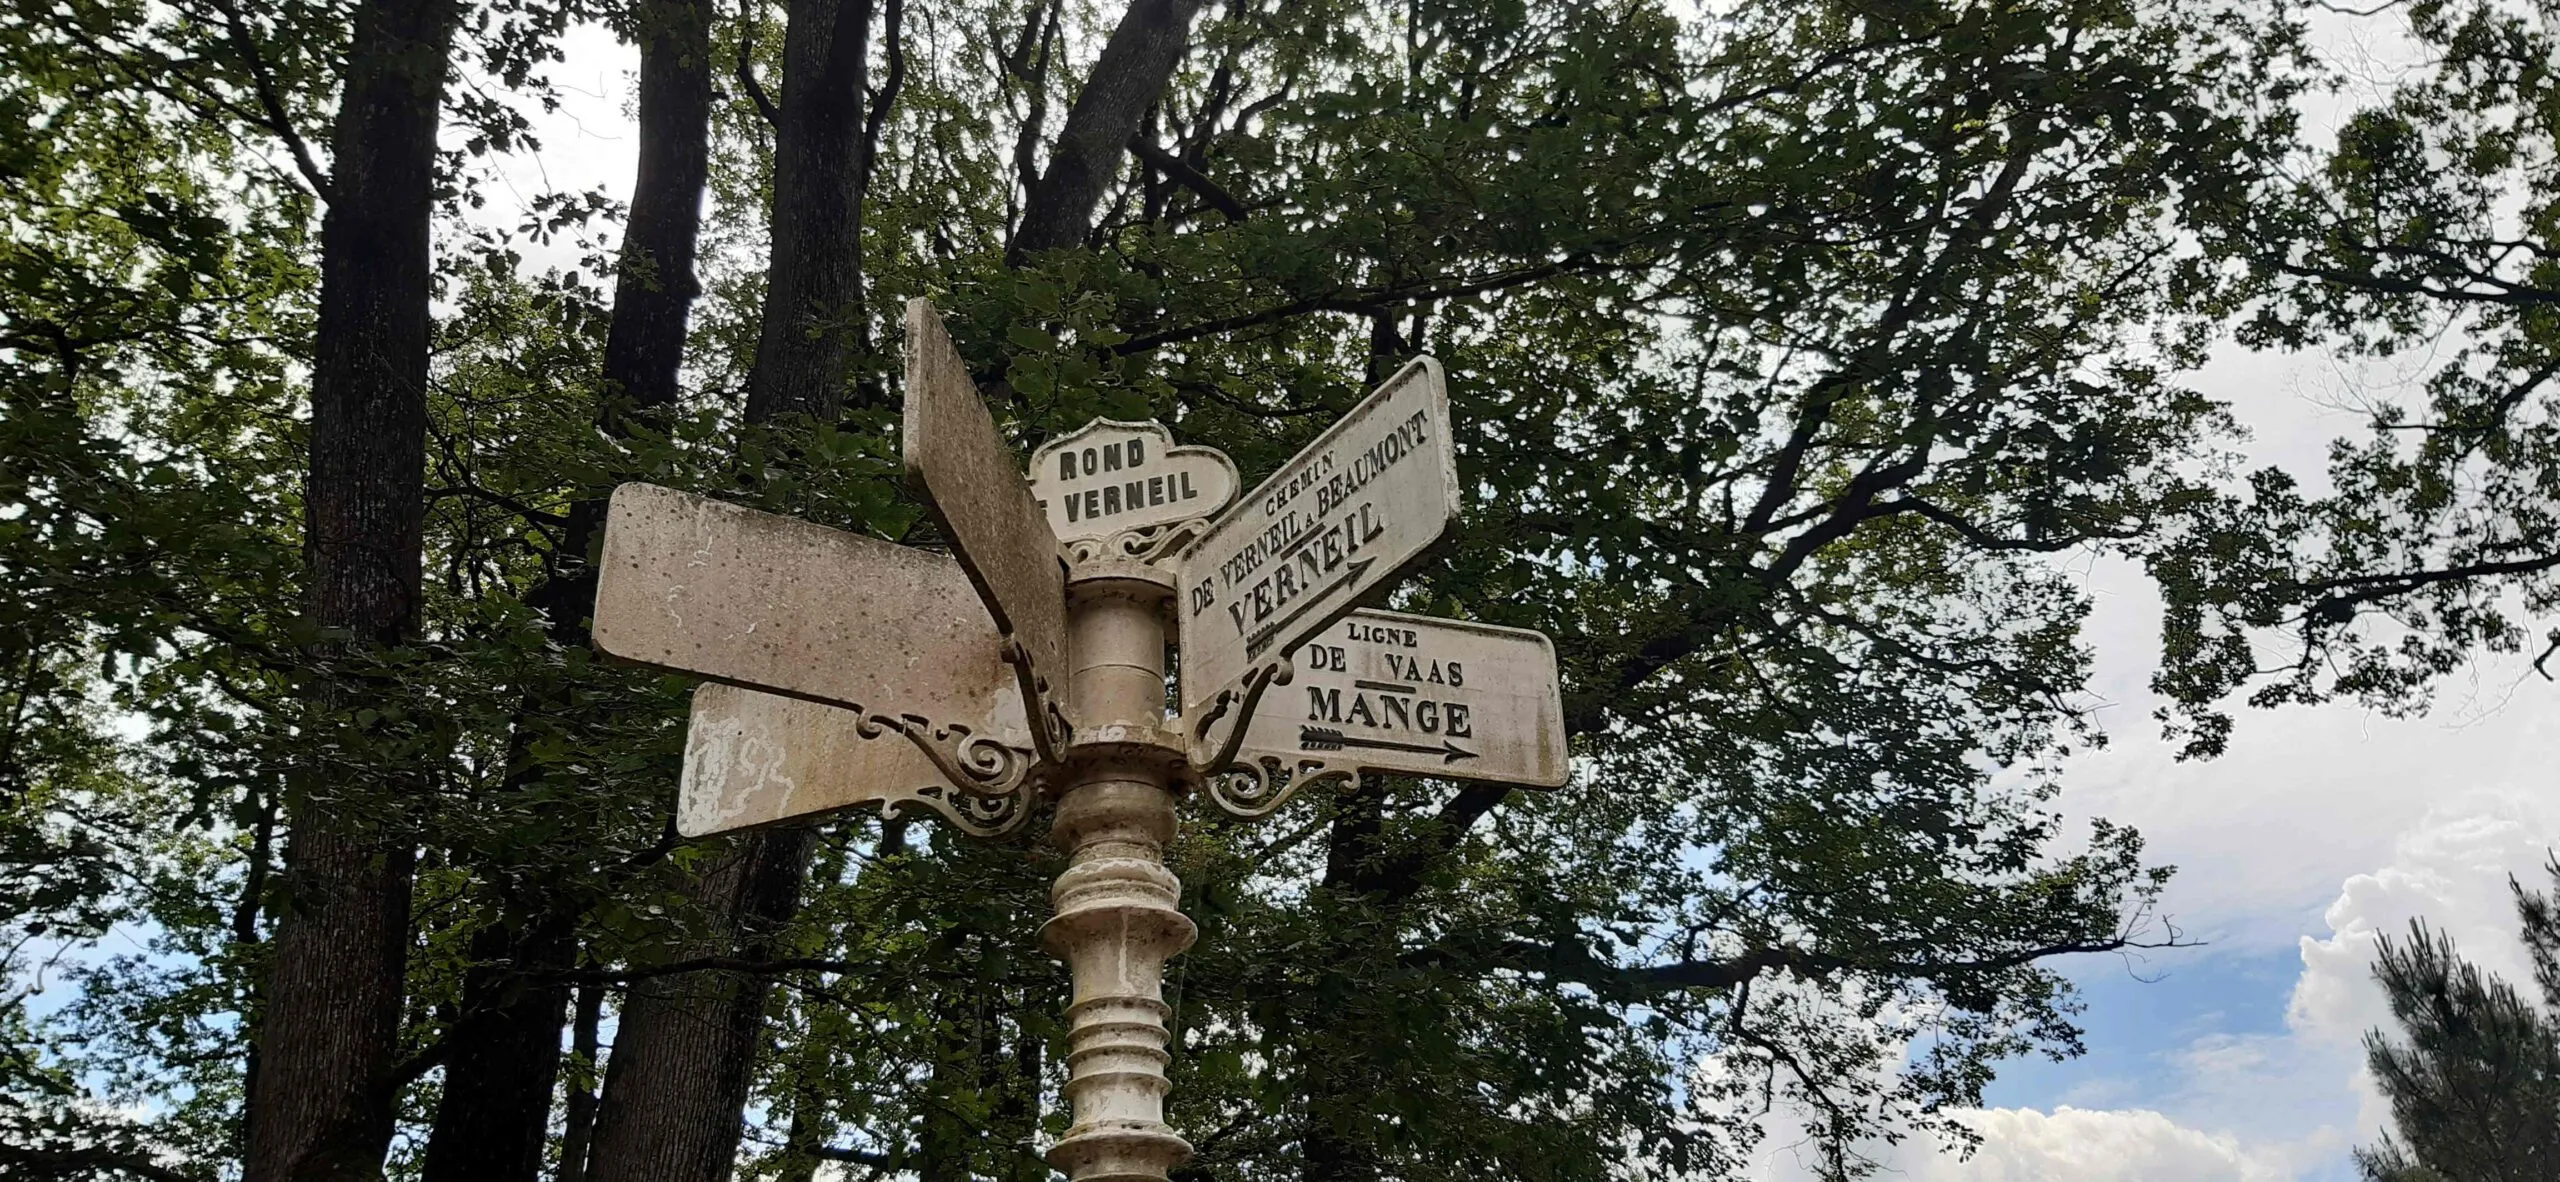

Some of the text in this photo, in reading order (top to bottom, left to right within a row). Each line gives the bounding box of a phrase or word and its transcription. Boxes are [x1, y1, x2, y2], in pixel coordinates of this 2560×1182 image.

[1060, 438, 1144, 481] ROND
[1266, 450, 1334, 516] CHEMIN
[1064, 471, 1197, 523] VERNEIL
[1192, 409, 1427, 616] DE VERNEIL A BEAUMONT
[1228, 502, 1384, 636] VERNEIL
[1347, 623, 1417, 647] LIGNE
[1309, 644, 1463, 687] DE VAAS
[1307, 686, 1471, 738] MANGE
